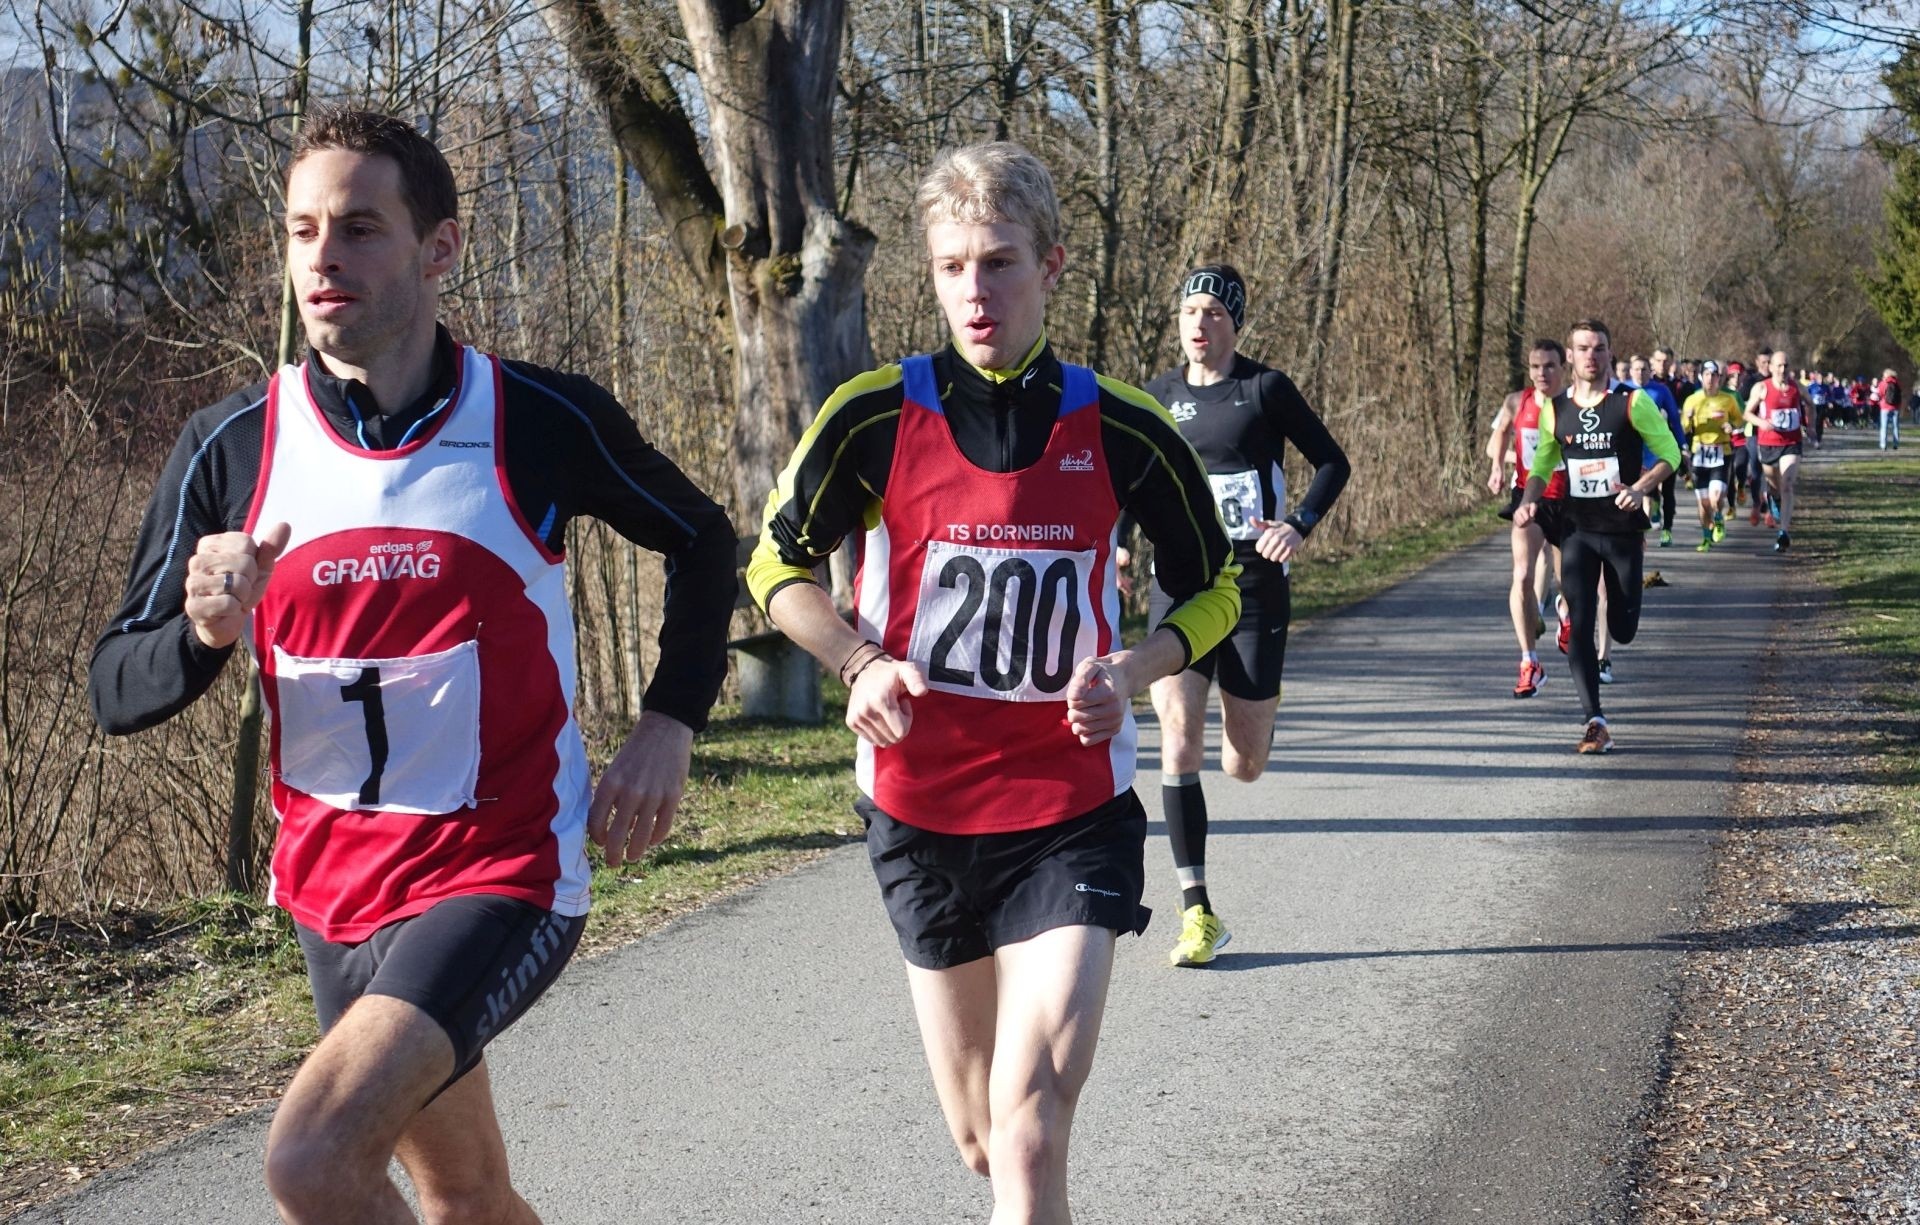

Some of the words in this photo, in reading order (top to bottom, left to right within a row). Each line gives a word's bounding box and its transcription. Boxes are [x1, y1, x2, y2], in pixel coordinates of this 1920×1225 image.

[439, 439, 489, 449] BROOKS
[1575, 432, 1613, 443] SPORT
[1580, 478, 1610, 493] 371
[947, 524, 970, 540] TS
[976, 524, 1075, 541] DORNBIRN
[369, 541, 414, 554] erdgas
[312, 553, 441, 587] GRAVAG
[928, 555, 1080, 694] 200
[340, 667, 388, 803] 1
[1075, 883, 1121, 897] Champion
[475, 910, 570, 1037] skinfit
